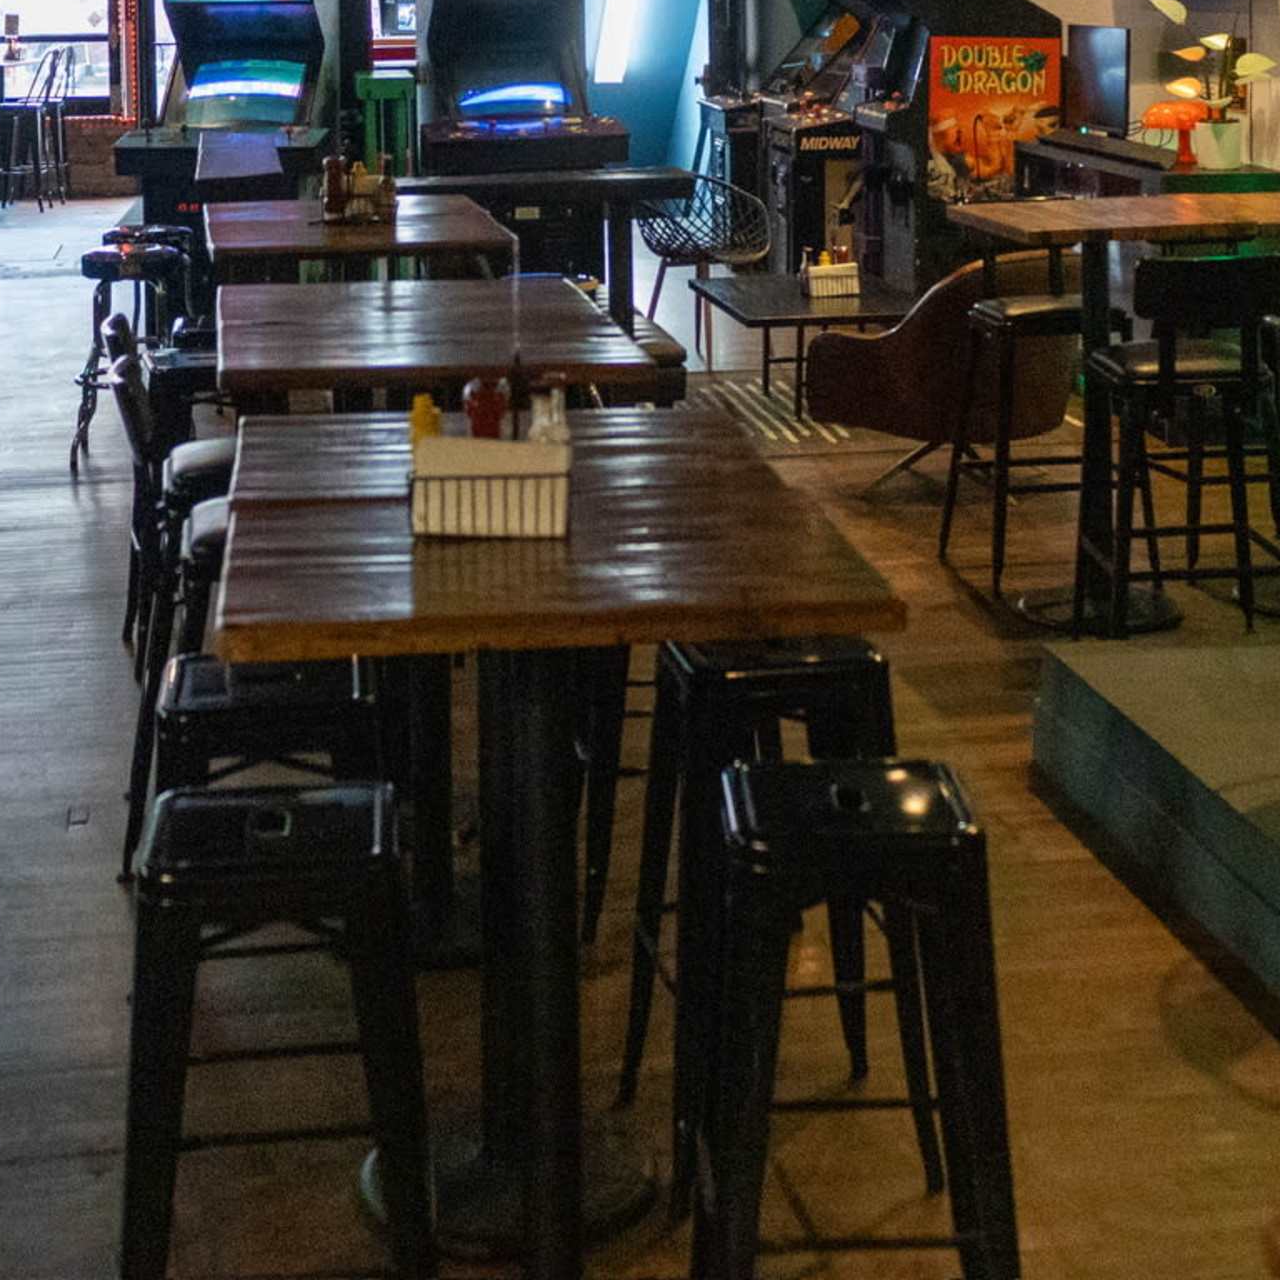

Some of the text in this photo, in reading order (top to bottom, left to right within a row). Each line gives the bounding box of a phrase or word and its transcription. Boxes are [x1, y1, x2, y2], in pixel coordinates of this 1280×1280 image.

[941, 44, 1025, 68] DOUBLE
[955, 69, 1046, 97] DRAGON
[800, 136, 860, 151] MIDWAY
